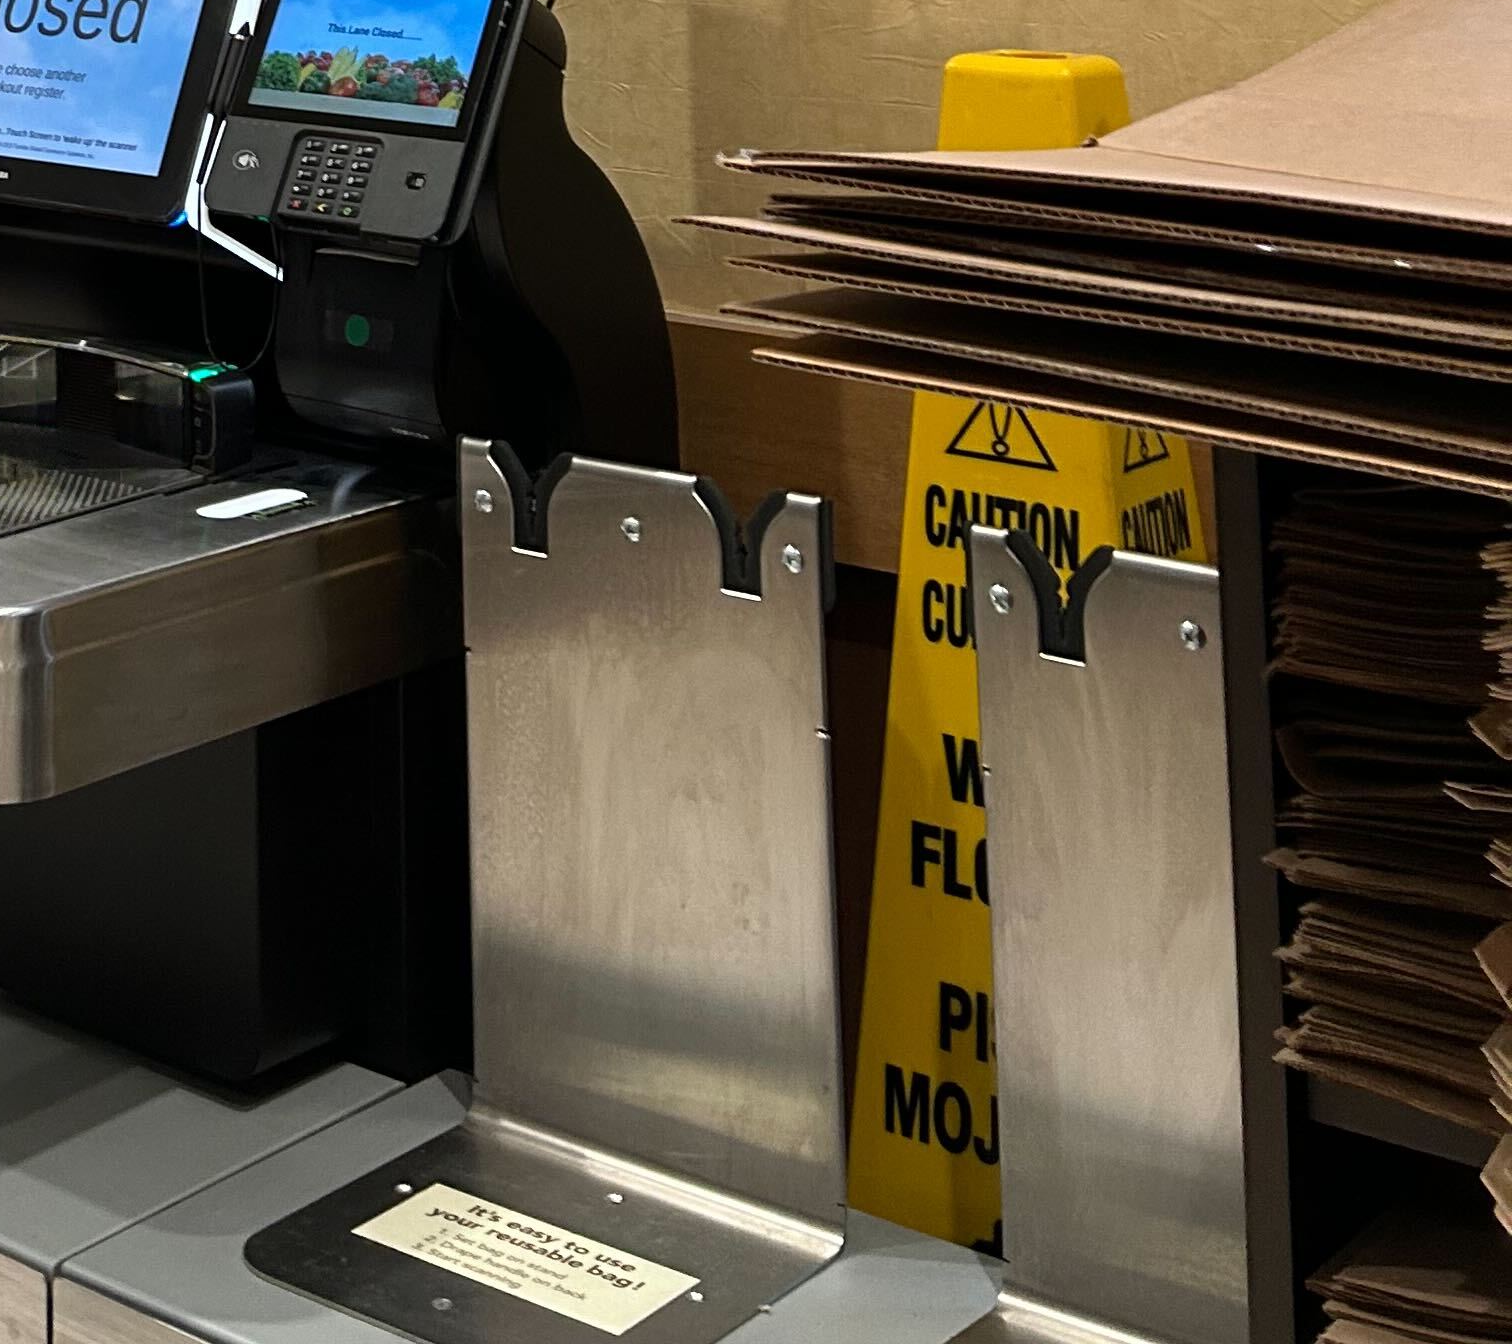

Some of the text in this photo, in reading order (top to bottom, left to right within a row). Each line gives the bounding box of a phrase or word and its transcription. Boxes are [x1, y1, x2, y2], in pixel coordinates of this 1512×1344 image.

[328, 22, 347, 34] This
[348, 25, 370, 37] Lane
[5, 63, 43, 79] choose
[44, 69, 87, 83] another
[1122, 488, 1192, 557] CAUTION
[426, 1207, 646, 1291] your reusable bag!
[453, 1233, 476, 1247] Set
[477, 1243, 505, 1258] bag
[506, 1255, 526, 1265] on
[526, 1262, 569, 1281] stand
[467, 1204, 636, 1273] It's easy to use
[428, 1248, 461, 1265] Start
[461, 1262, 522, 1290] scanning
[440, 1241, 482, 1260] Drape
[483, 1258, 530, 1279] handle
[532, 1277, 552, 1287] on
[553, 1284, 586, 1300] back
